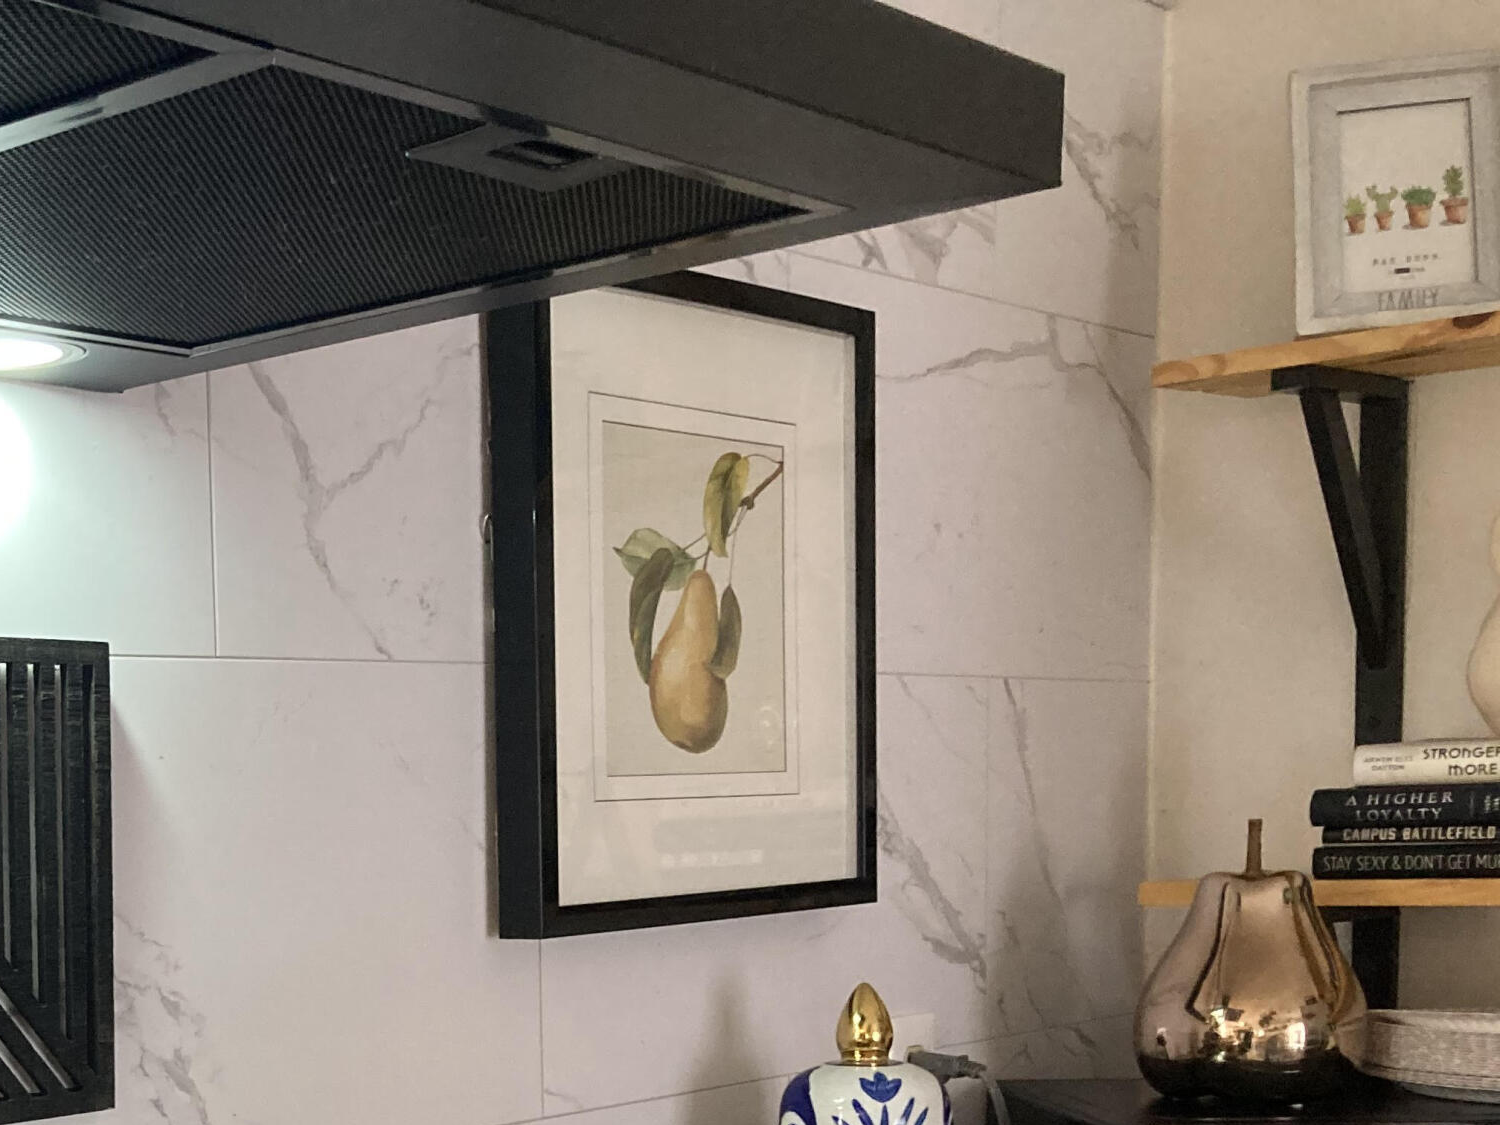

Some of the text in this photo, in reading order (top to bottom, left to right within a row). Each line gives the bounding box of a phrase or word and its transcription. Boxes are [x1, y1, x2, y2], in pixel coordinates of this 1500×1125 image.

[1345, 791, 1453, 806] A HIGHER
[1355, 807, 1443, 821] LOYALTY
[1342, 826, 1496, 841] CAMPUS BATTLEFIELD
[1323, 855, 1351, 871] STAY
[1357, 855, 1388, 871] SEXY
[1391, 854, 1401, 870] &
[1404, 854, 1444, 871] DON'T
[1447, 854, 1472, 870] GET
